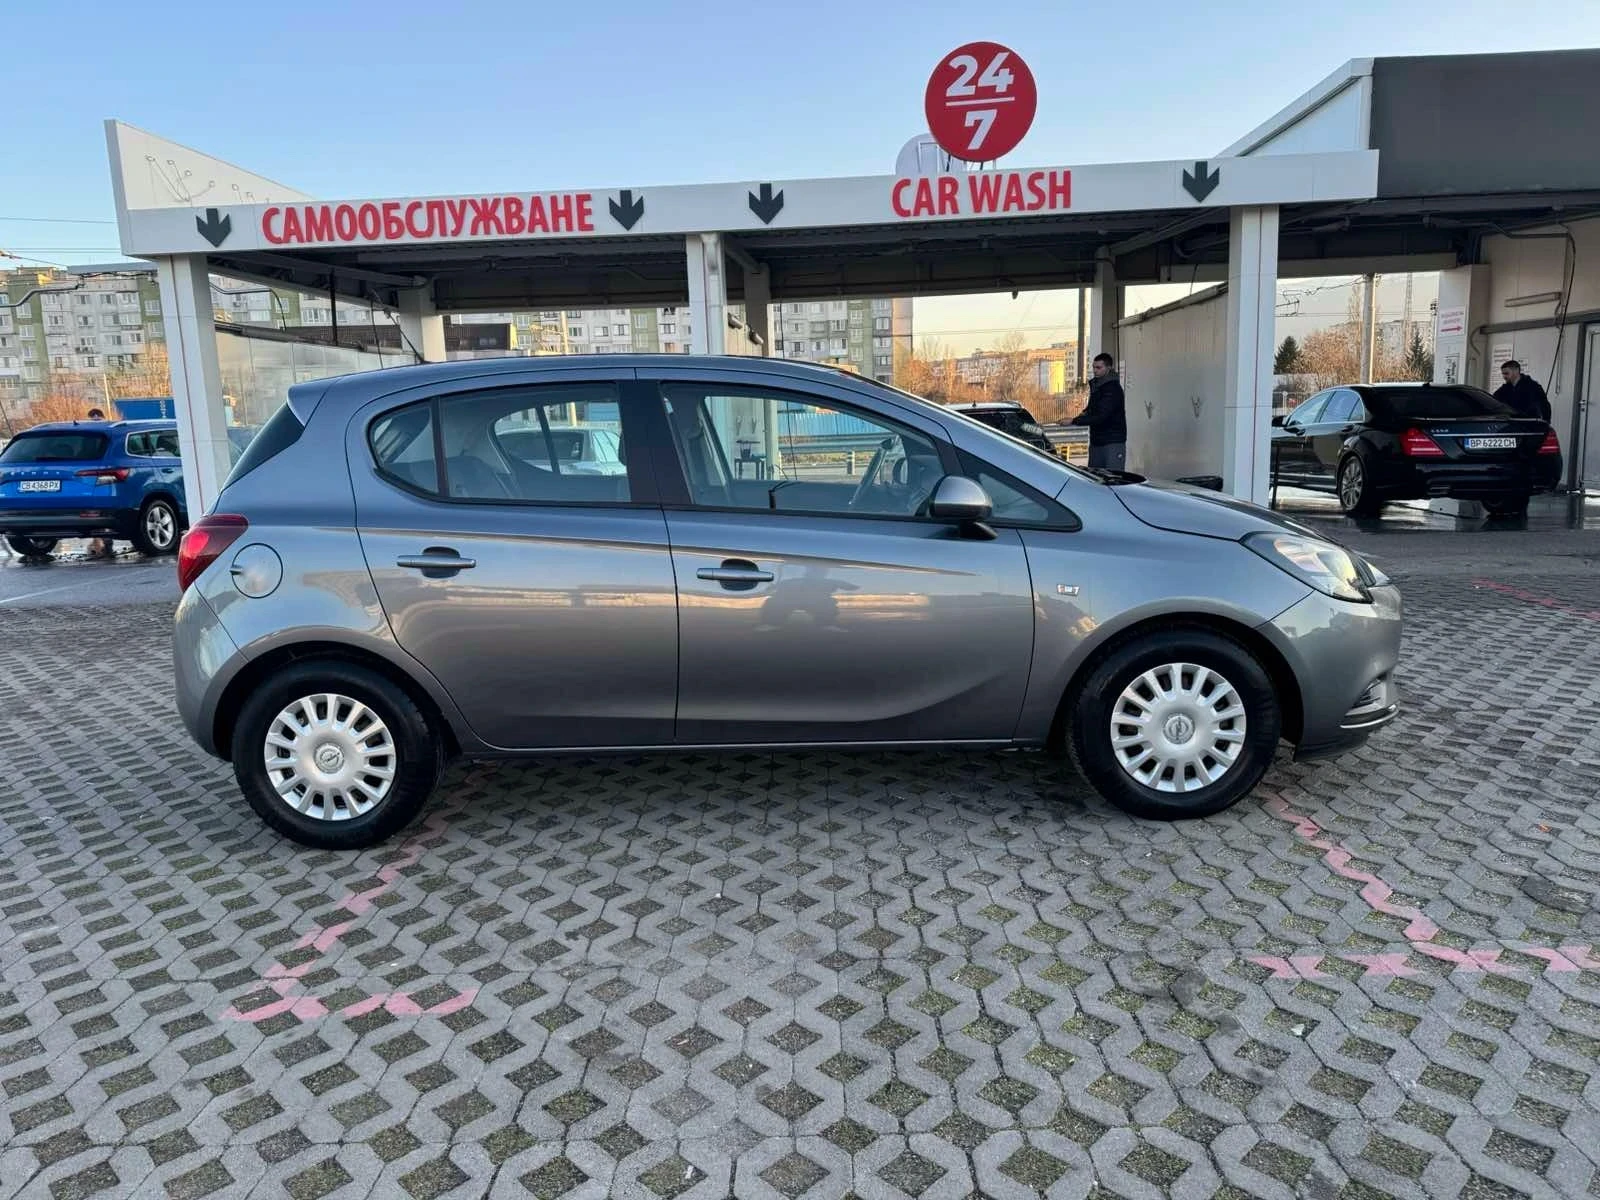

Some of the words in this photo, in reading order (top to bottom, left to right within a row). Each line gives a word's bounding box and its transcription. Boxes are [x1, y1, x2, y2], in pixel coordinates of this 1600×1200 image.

[946, 52, 1015, 97] 24
[965, 109, 998, 150] 7
[892, 176, 960, 217] CAR
[967, 170, 1072, 213] WASH
[262, 193, 594, 244] САМООБСЛУЖВАНЕ
